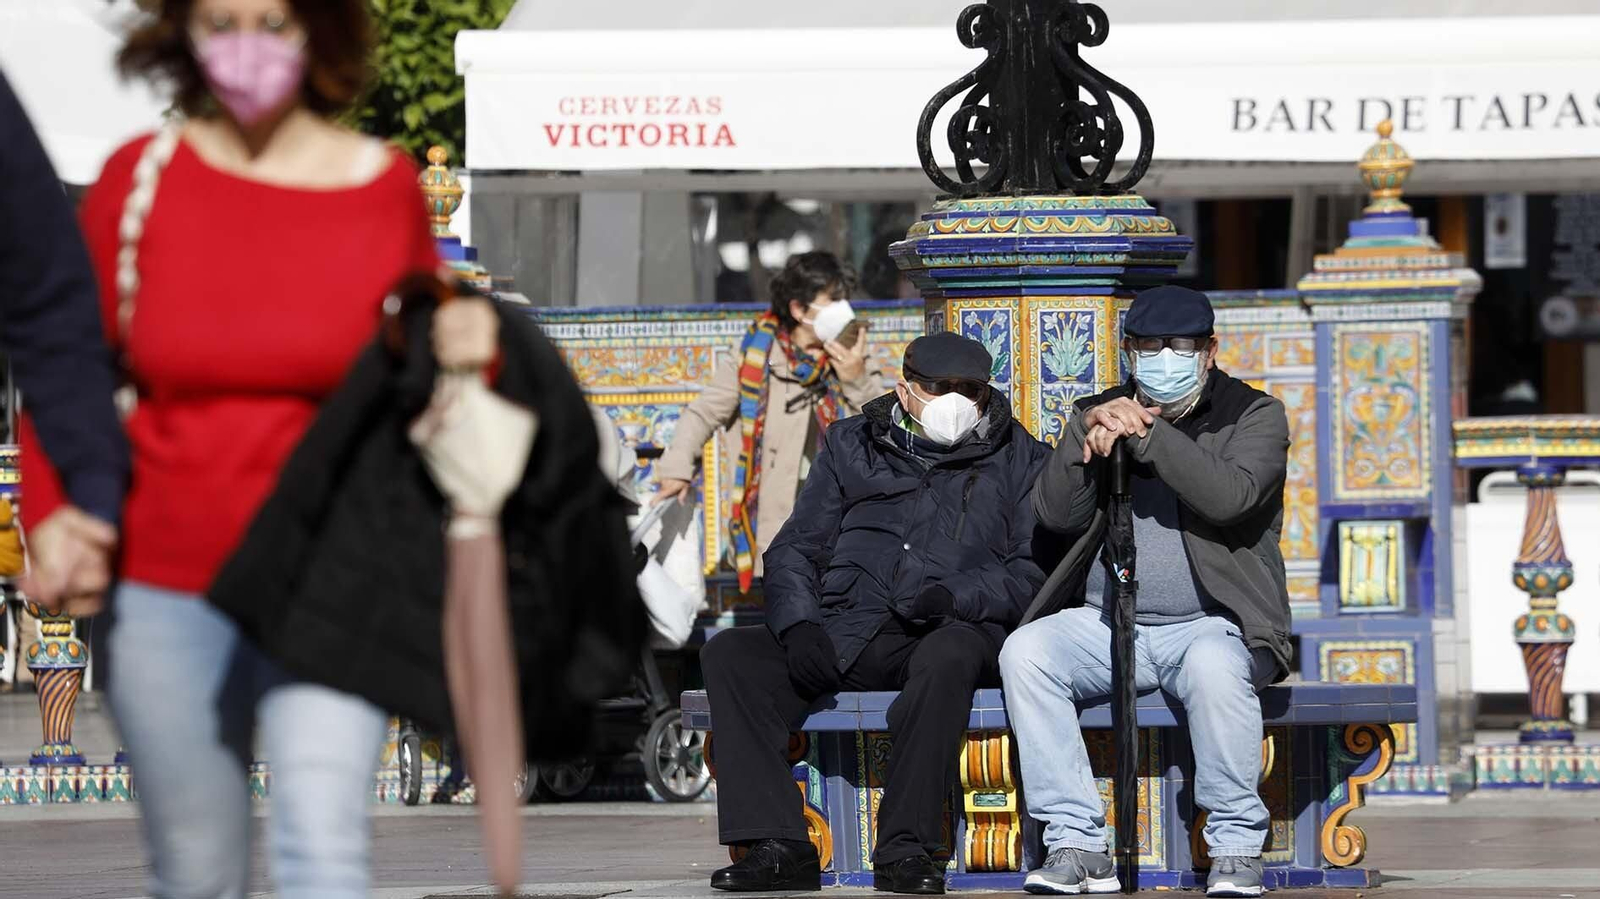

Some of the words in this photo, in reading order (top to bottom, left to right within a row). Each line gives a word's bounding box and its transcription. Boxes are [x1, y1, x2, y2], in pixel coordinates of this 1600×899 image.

[558, 95, 723, 116] CERVEZAS
[1231, 97, 1337, 133] BAR
[1355, 97, 1427, 133] DE
[542, 122, 738, 148] VICTORIA
